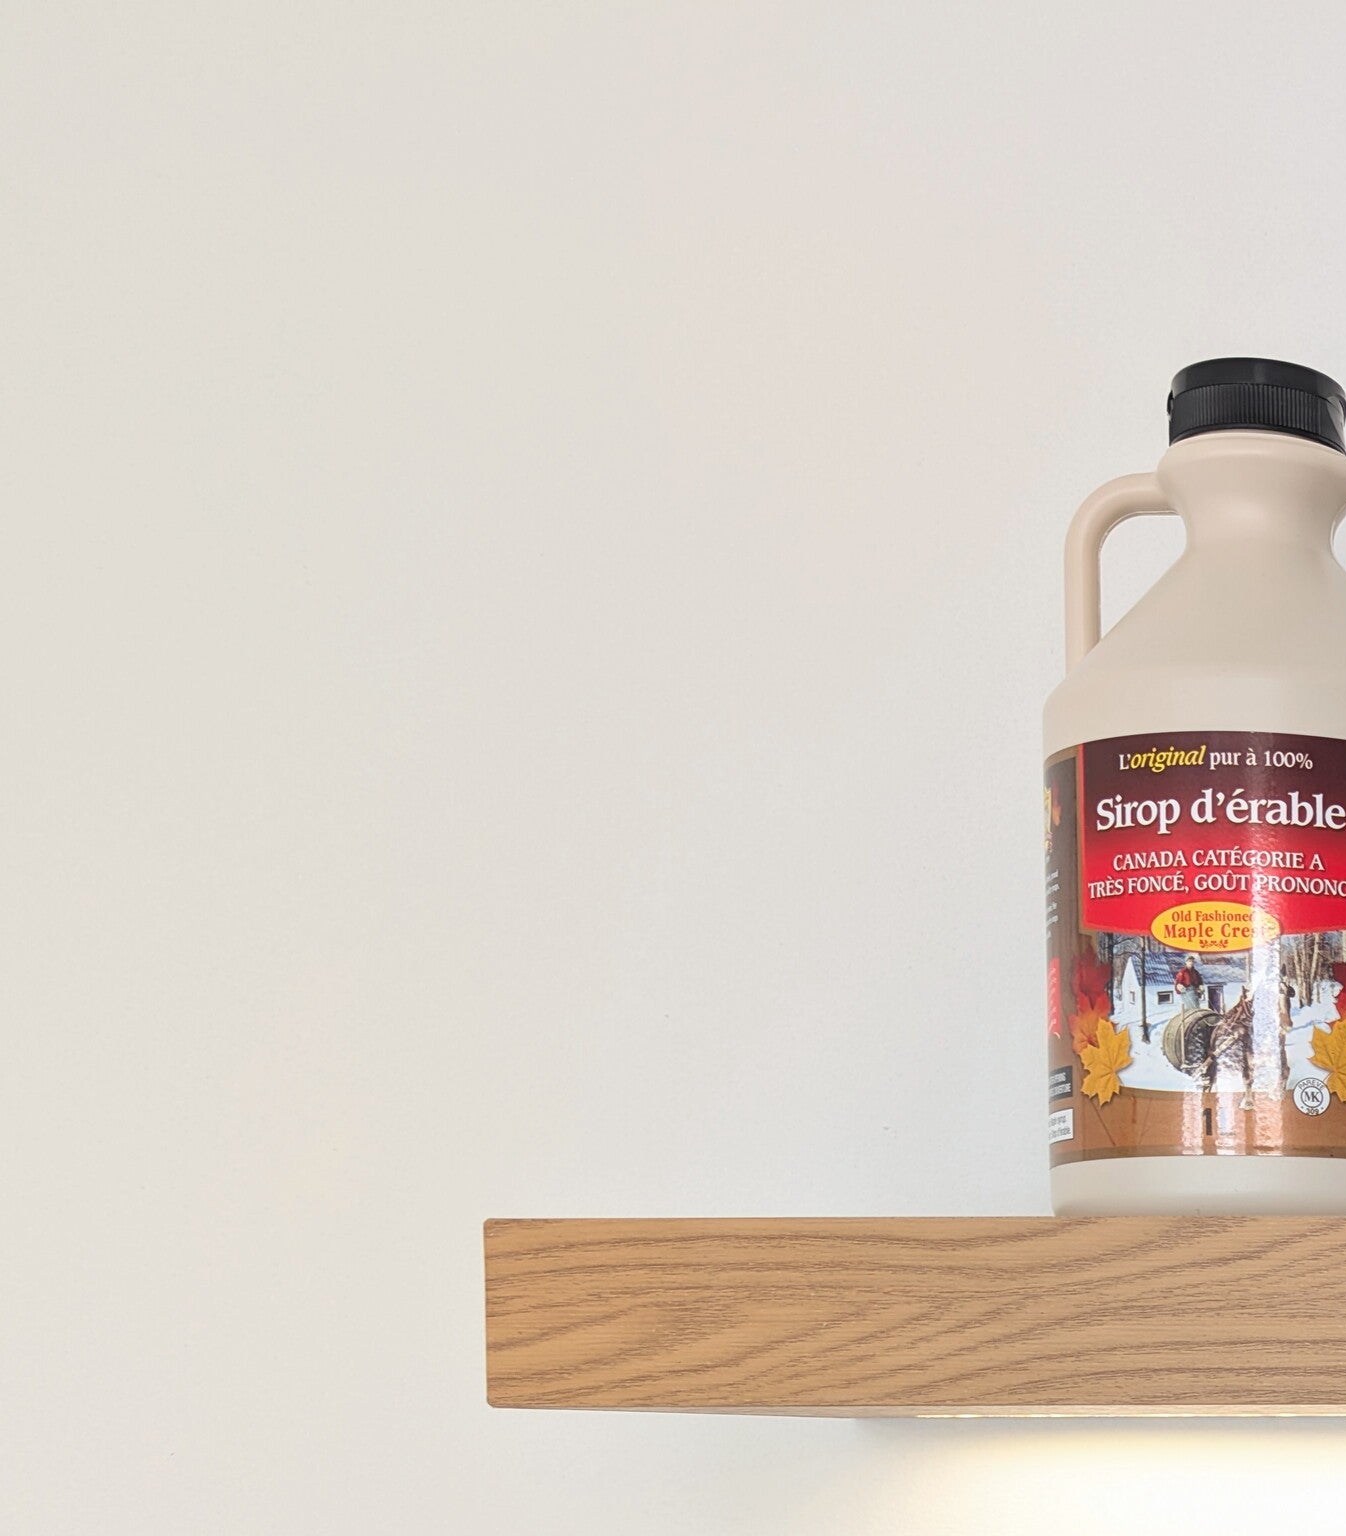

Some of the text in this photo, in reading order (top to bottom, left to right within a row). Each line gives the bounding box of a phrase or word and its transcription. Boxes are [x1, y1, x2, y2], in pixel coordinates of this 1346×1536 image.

[1210, 752, 1241, 770] pur
[1246, 748, 1257, 766] à
[1265, 751, 1313, 770] 100%
[1097, 794, 1180, 834] Sirop
[1191, 788, 1346, 830] d'érable
[1113, 846, 1325, 871] CANADA CATÉGORIE A
[1088, 876, 1124, 899] TRÈS
[1128, 872, 1189, 894] FONCÉ,
[1194, 870, 1250, 891] GOÛT
[1171, 911, 1192, 922] Old
[1164, 923, 1214, 942] Maple
[1203, 1108, 1212, 1136] 1
